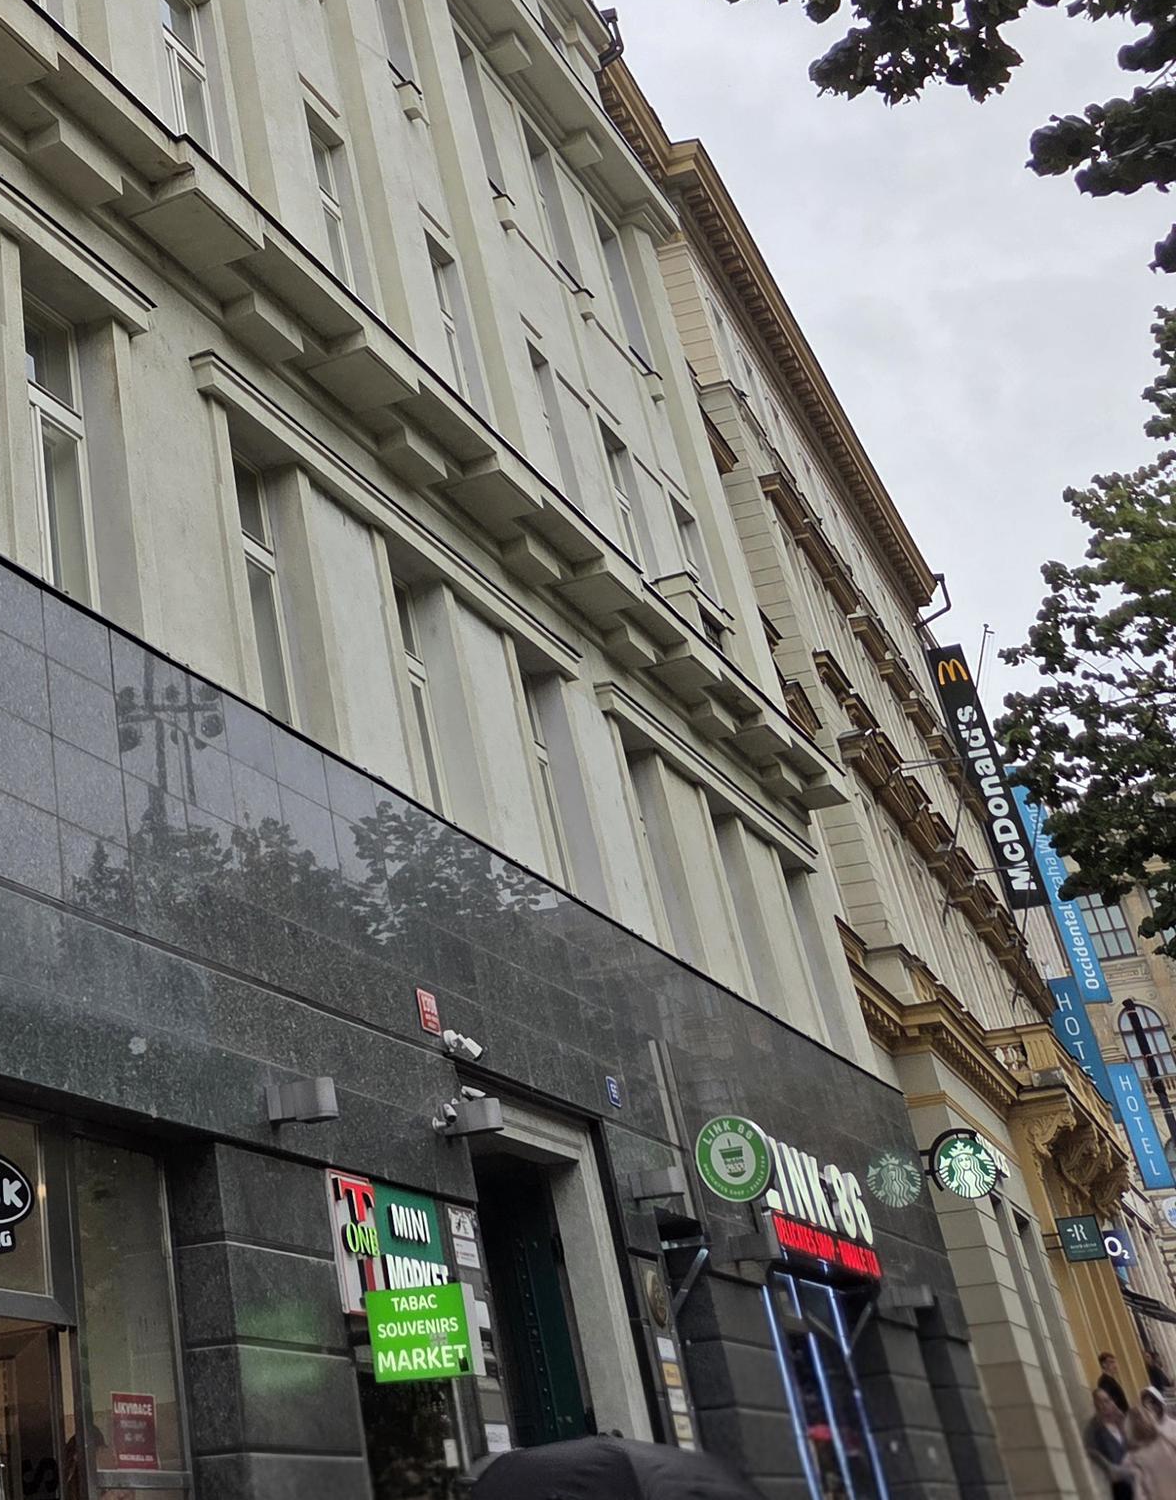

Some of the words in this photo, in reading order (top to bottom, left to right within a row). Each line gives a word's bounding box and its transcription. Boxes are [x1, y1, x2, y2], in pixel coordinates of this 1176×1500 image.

[957, 706, 1037, 891] McDonald's
[1045, 857, 1065, 902] raha
[703, 1120, 731, 1145] LINK
[1119, 1076, 1160, 1176] HOTEL
[766, 1136, 837, 1232] INK
[824, 1164, 873, 1245] 86
[346, 1221, 381, 1258] ONE
[390, 1203, 431, 1244] MINI
[391, 1294, 438, 1312] TABAC
[377, 1317, 459, 1339] SOUVENIRS
[378, 1344, 467, 1373] MARKET
